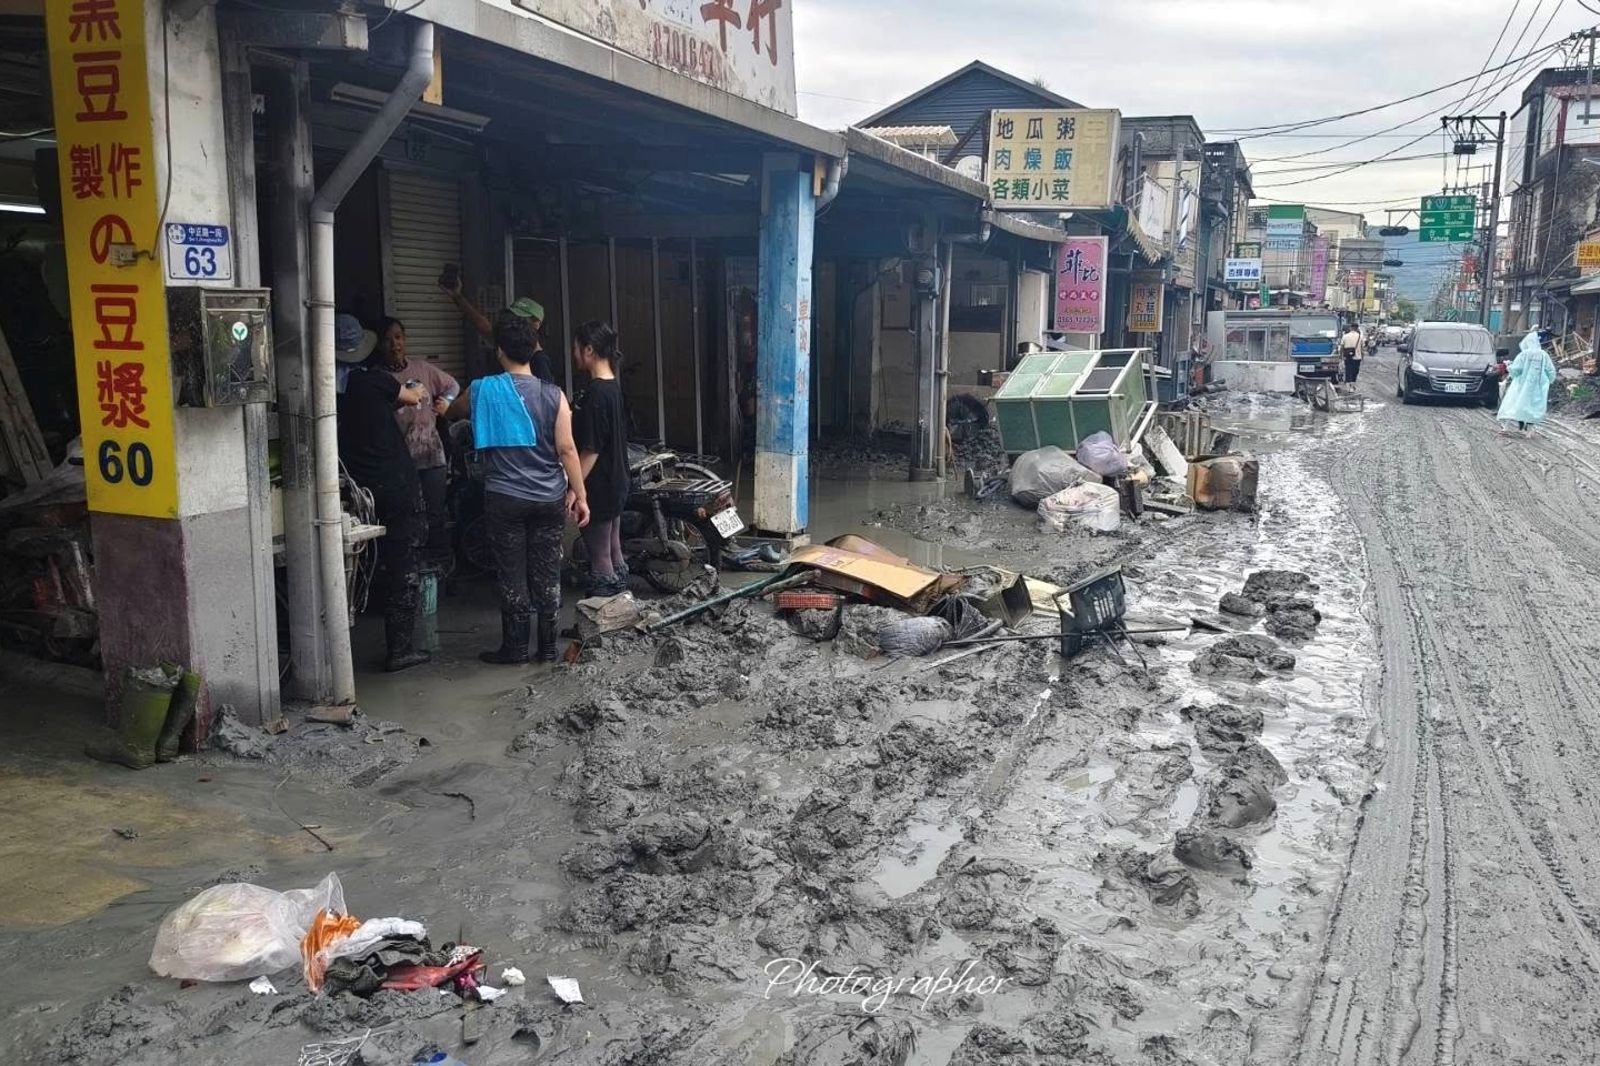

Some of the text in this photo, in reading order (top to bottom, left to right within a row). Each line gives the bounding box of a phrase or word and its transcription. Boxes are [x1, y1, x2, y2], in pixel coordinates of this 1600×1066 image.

[995, 117, 1075, 140] 地瓜粥
[994, 147, 1073, 171] 肉燥飯
[992, 178, 1071, 201] 各類小菜
[185, 247, 217, 276] 63
[99, 440, 154, 487] 60
